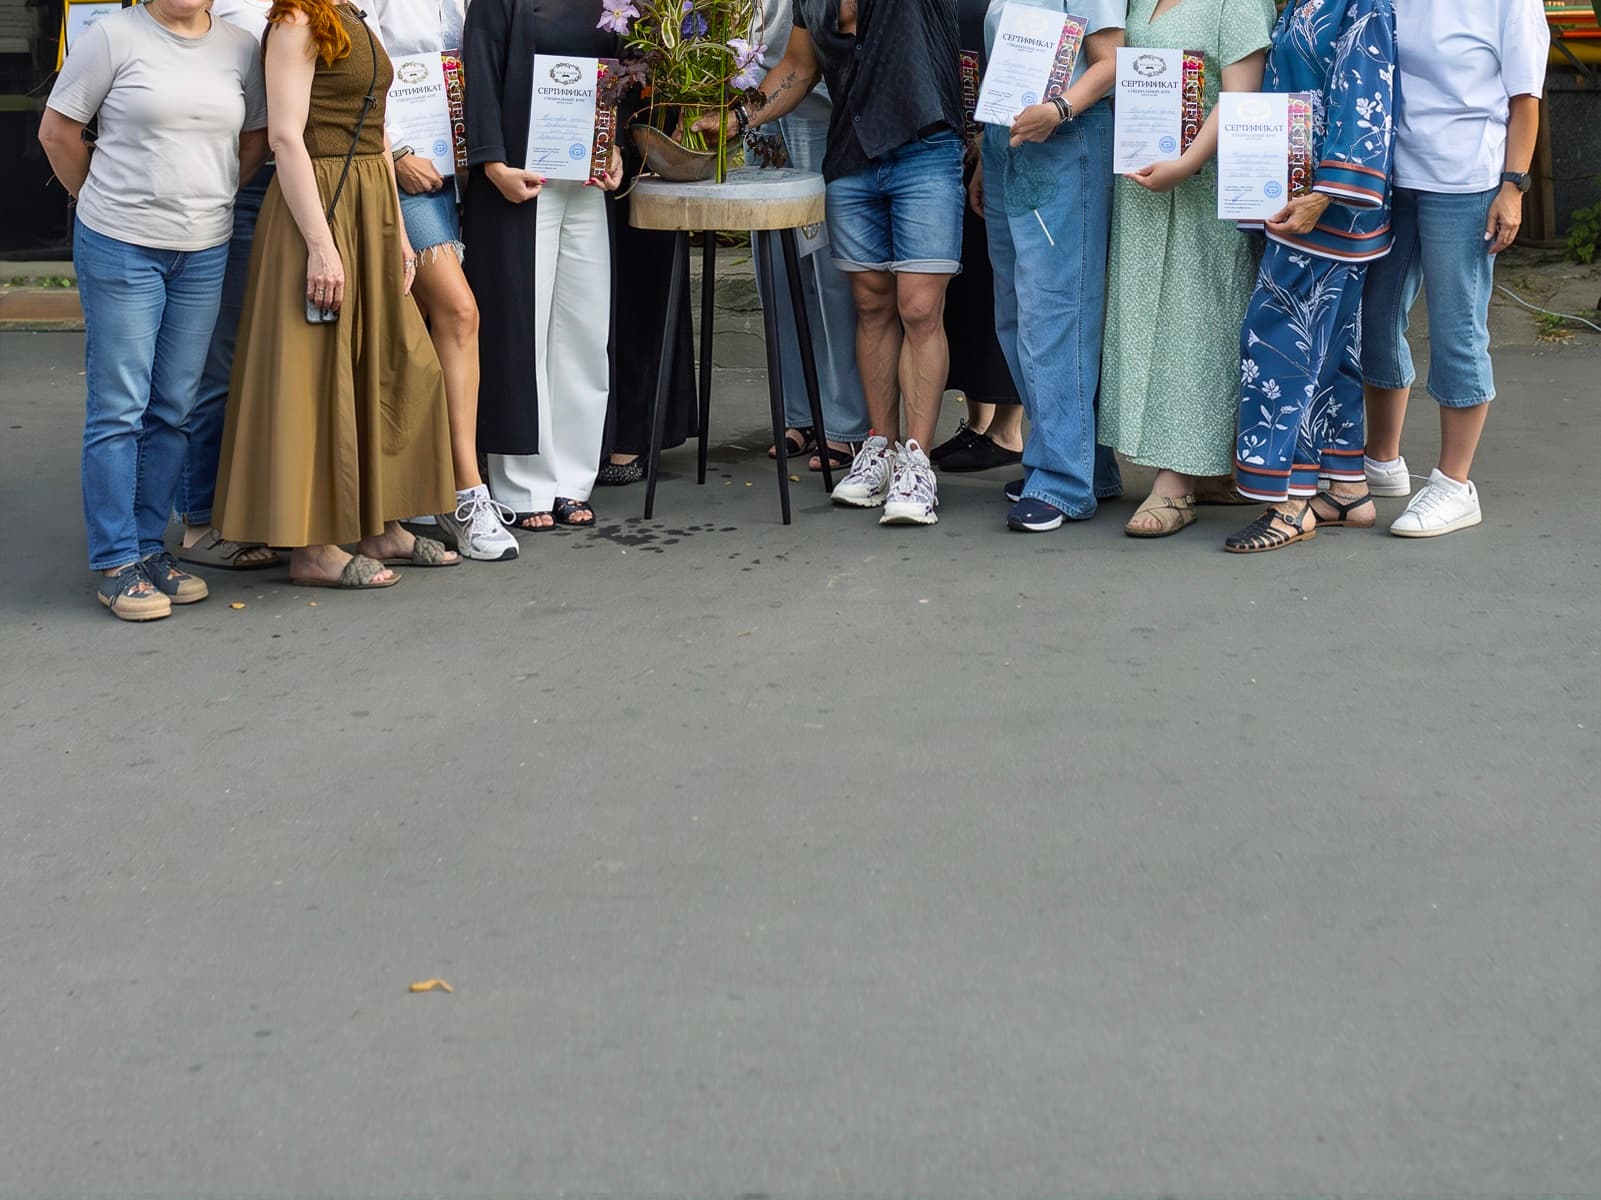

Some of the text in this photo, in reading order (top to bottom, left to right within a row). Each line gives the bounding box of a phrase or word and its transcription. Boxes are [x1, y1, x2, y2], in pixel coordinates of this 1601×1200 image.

[1002, 33, 1055, 49] СЕРТИФИКАТ
[1048, 21, 1080, 101] CERTIFIC
[389, 84, 442, 98] СЕРТИФИКАТ
[537, 87, 593, 98] СЕРТИФИКАТ
[1121, 80, 1178, 89] СЕРТИФИКАТ
[1184, 56, 1199, 148] CERTIFICA
[446, 56, 468, 168] CERTIFICATE
[1224, 123, 1284, 133] СЕРТИФИКАТ
[593, 102, 611, 176] IFICATE
[1291, 99, 1305, 201] CERTIFICAT
